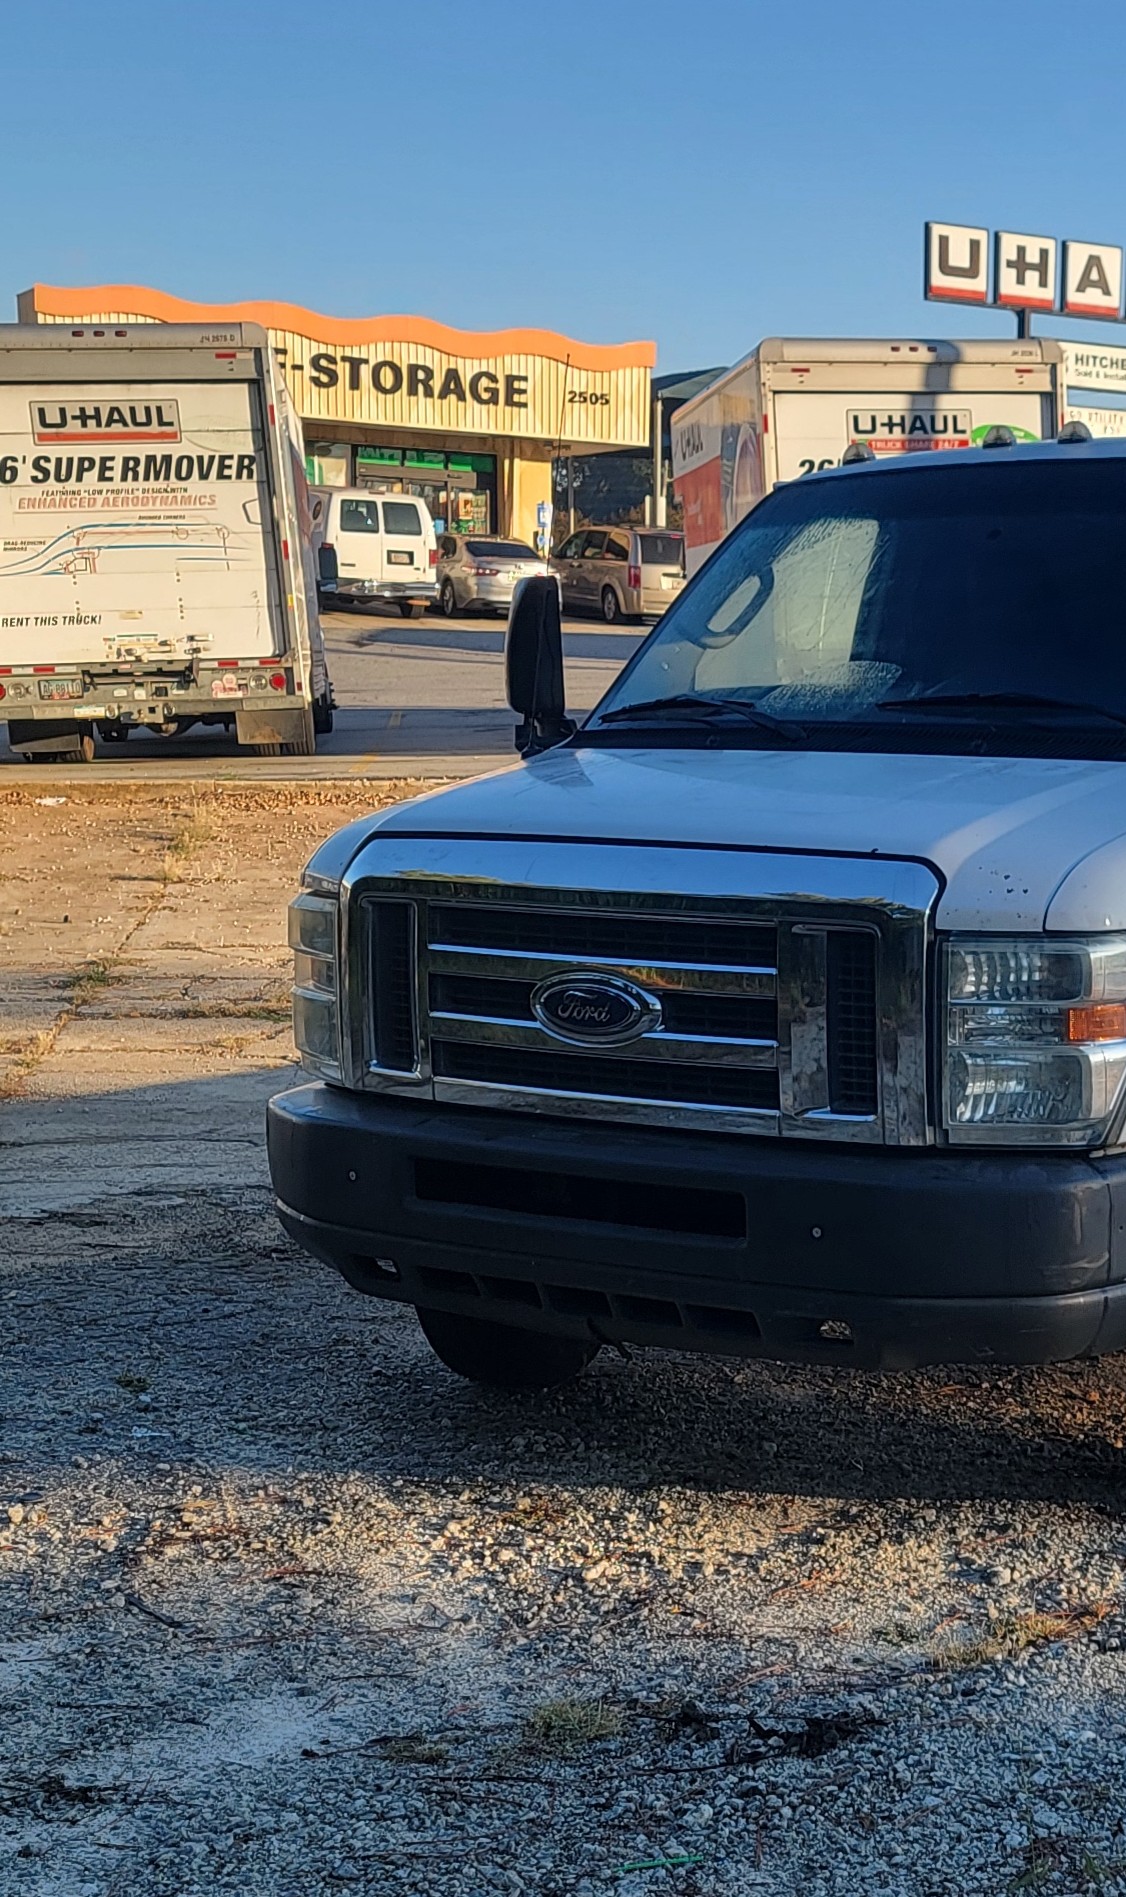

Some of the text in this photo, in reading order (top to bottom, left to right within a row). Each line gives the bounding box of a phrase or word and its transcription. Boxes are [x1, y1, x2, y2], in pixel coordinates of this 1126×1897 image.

[274, 347, 529, 408] -STORAGE
[567, 389, 610, 406] 2505
[37, 405, 175, 429] U-HAUL
[852, 414, 967, 435] U-HAUL
[871, 440, 902, 450] TRUCK
[17, 494, 217, 510] ENHANCED AERODYNAMICS
[1, 614, 102, 628] RENT THIS TRUCK!
[557, 990, 612, 1022] Ford
